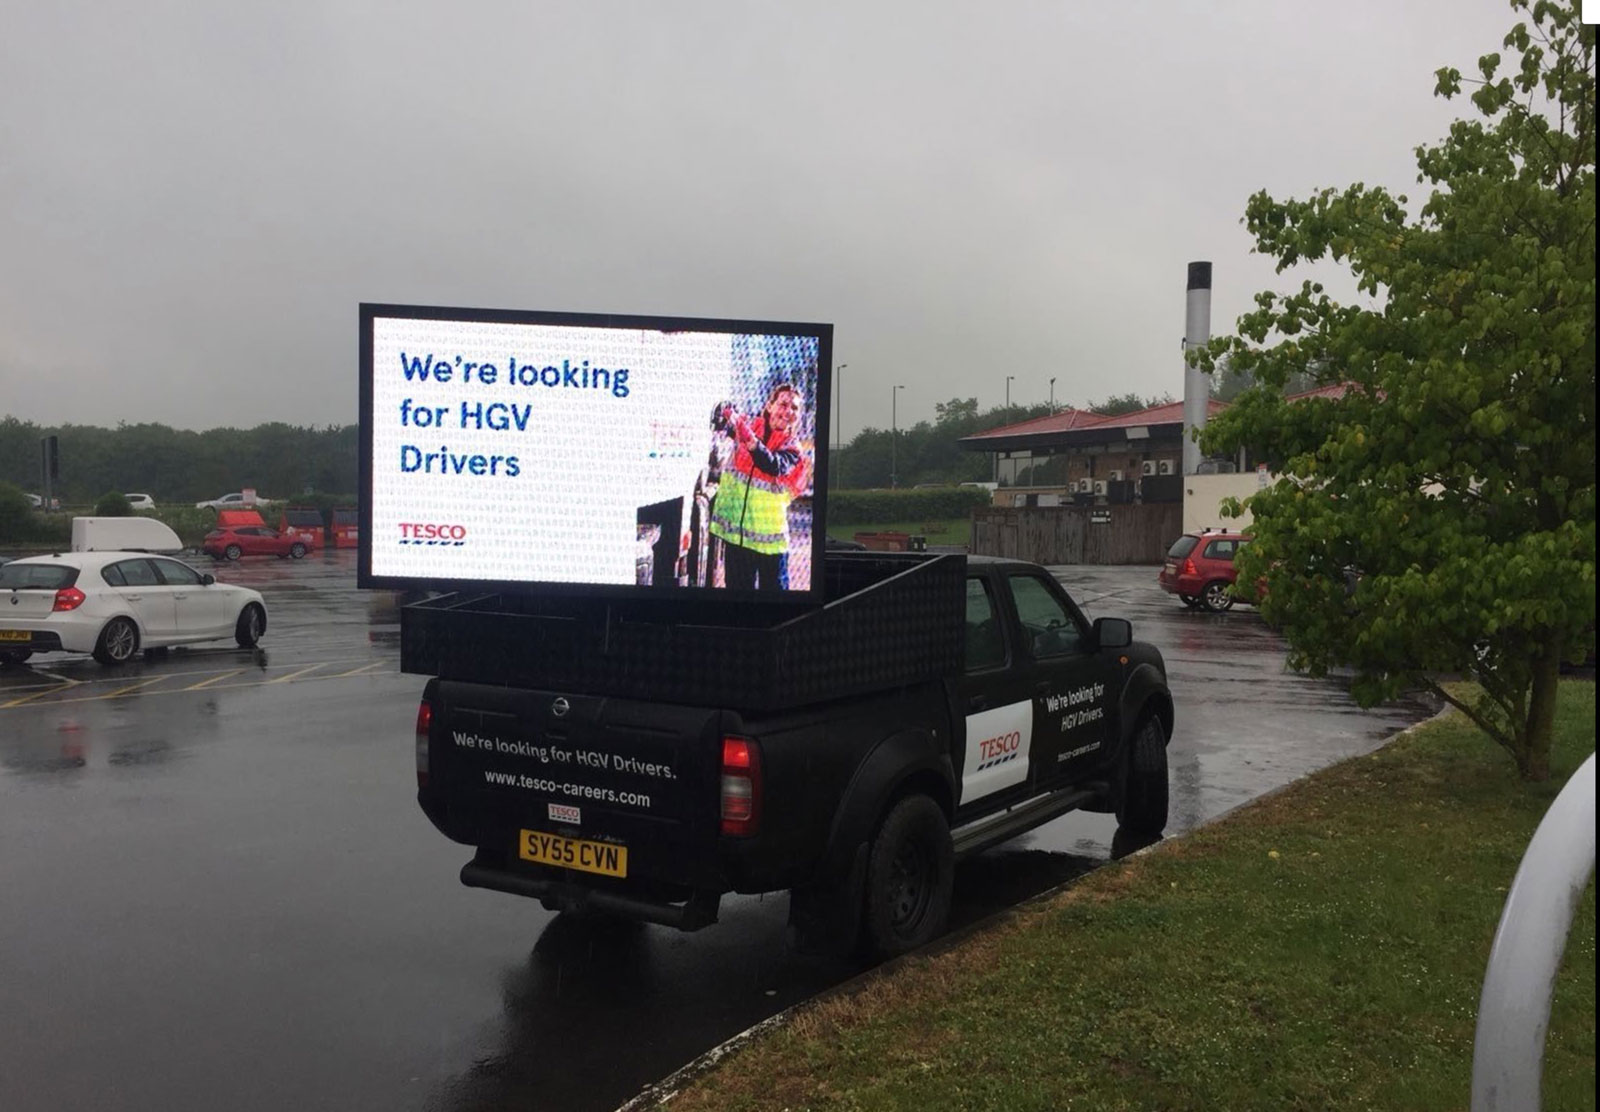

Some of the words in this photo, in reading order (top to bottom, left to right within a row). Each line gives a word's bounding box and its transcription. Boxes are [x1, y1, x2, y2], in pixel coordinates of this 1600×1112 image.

[401, 352, 498, 385] We’re
[509, 357, 630, 398] looking
[400, 398, 449, 427] for
[461, 401, 532, 431] HGV
[401, 445, 520, 477] Drivers
[398, 523, 467, 540] TESCO
[1046, 694, 1069, 713] We're
[1068, 686, 1094, 703] looking
[1093, 682, 1104, 697] for
[1061, 712, 1079, 732] HGV
[453, 731, 493, 751] We're
[495, 737, 549, 763] looking
[550, 746, 573, 763] for
[576, 750, 609, 769] HGV
[613, 754, 677, 780] Drivers.
[979, 731, 1021, 761] TESCO
[485, 771, 651, 808] www.tesco-careers.com
[550, 805, 579, 818] TESCO
[527, 834, 575, 863] SY55
[580, 842, 619, 872] CVN
